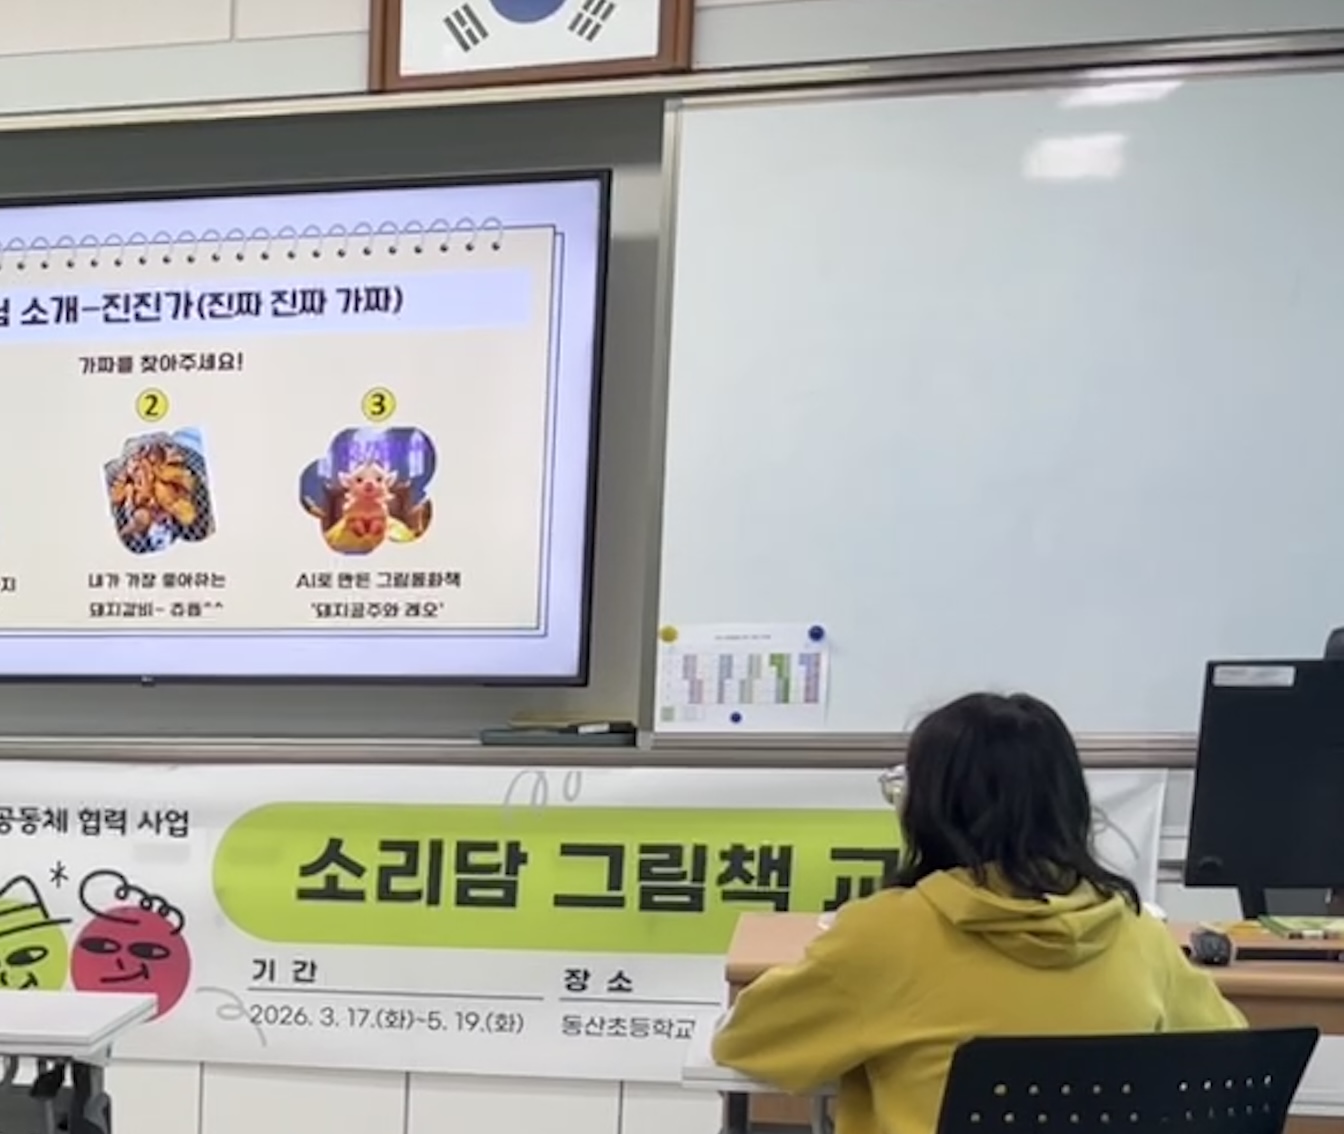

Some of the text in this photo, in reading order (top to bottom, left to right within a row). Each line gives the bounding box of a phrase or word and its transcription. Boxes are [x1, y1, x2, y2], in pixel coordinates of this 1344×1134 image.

[20, 288, 263, 327] 소개-진진가(진짜
[270, 287, 327, 318] 진짜
[338, 284, 404, 315] 가짜)
[79, 352, 244, 376] 가짜를 찾아주세요!
[88, 572, 119, 589] 내가
[77, 807, 129, 836] 협력
[137, 809, 190, 838] 사업
[296, 837, 900, 913] 소리담 그림책 교
[249, 1004, 312, 1028] 2026.
[319, 1005, 340, 1029] 3.
[562, 1014, 697, 1040] 동산초등학교
